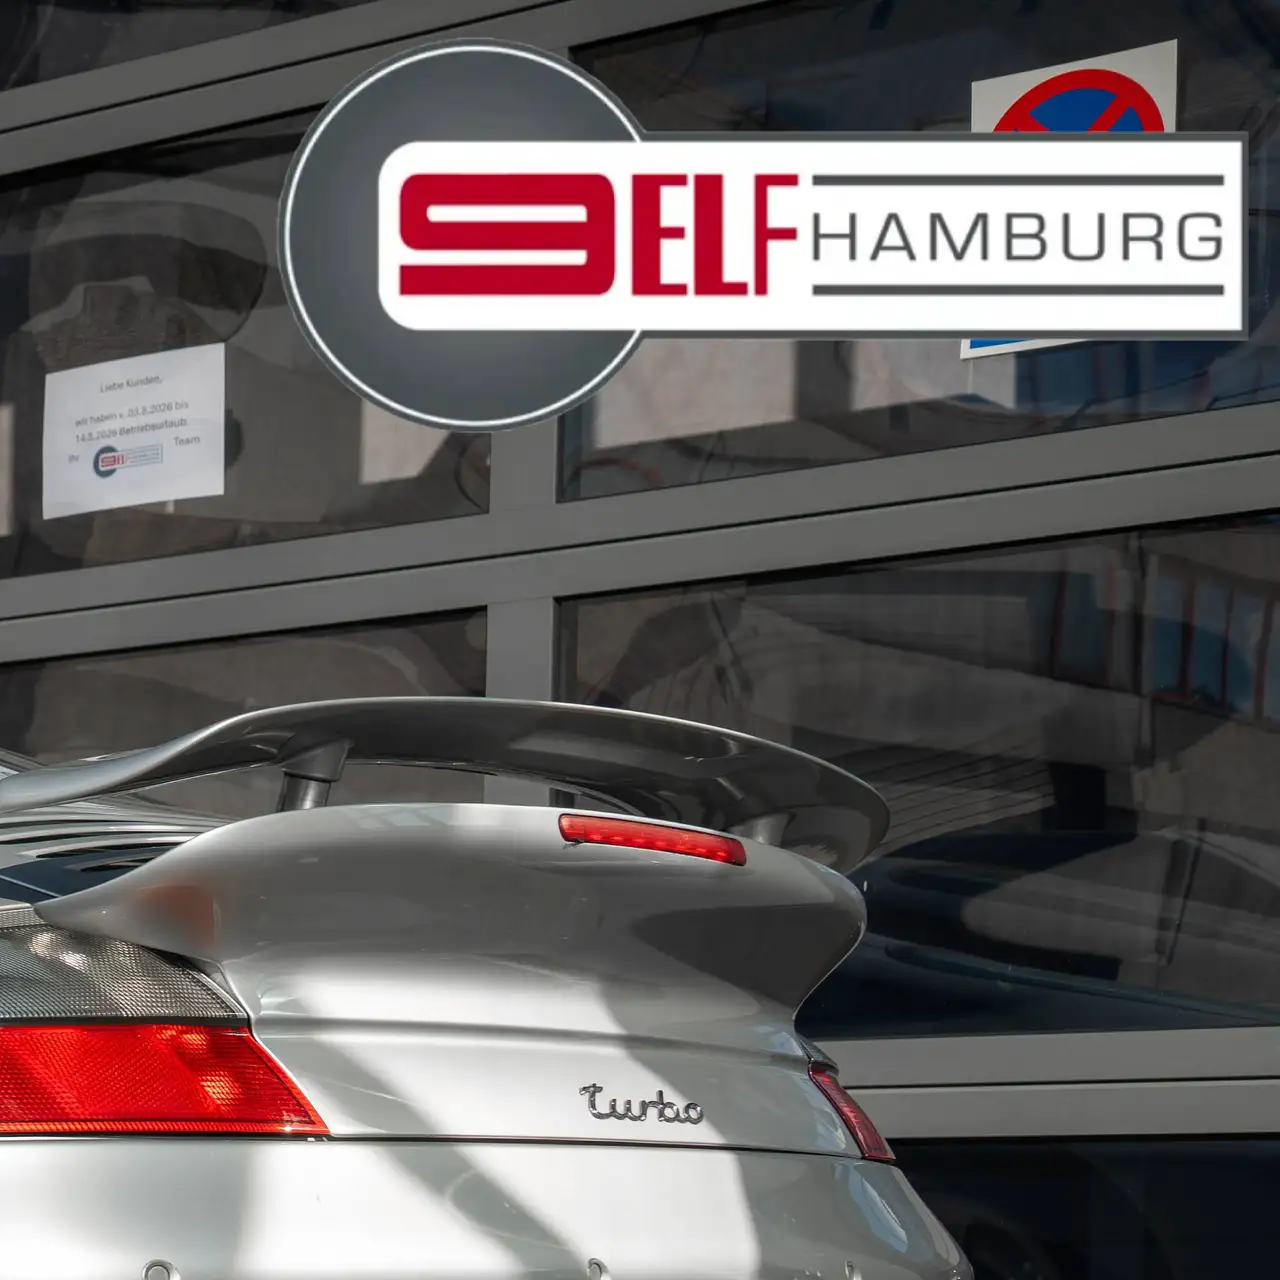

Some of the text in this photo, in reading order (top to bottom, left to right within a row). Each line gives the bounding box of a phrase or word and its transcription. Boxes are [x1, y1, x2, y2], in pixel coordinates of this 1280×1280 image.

[100, 380, 124, 393] Liebe
[175, 400, 189, 410] bis
[174, 434, 200, 447] Team
[579, 1083, 704, 1125] turbo
